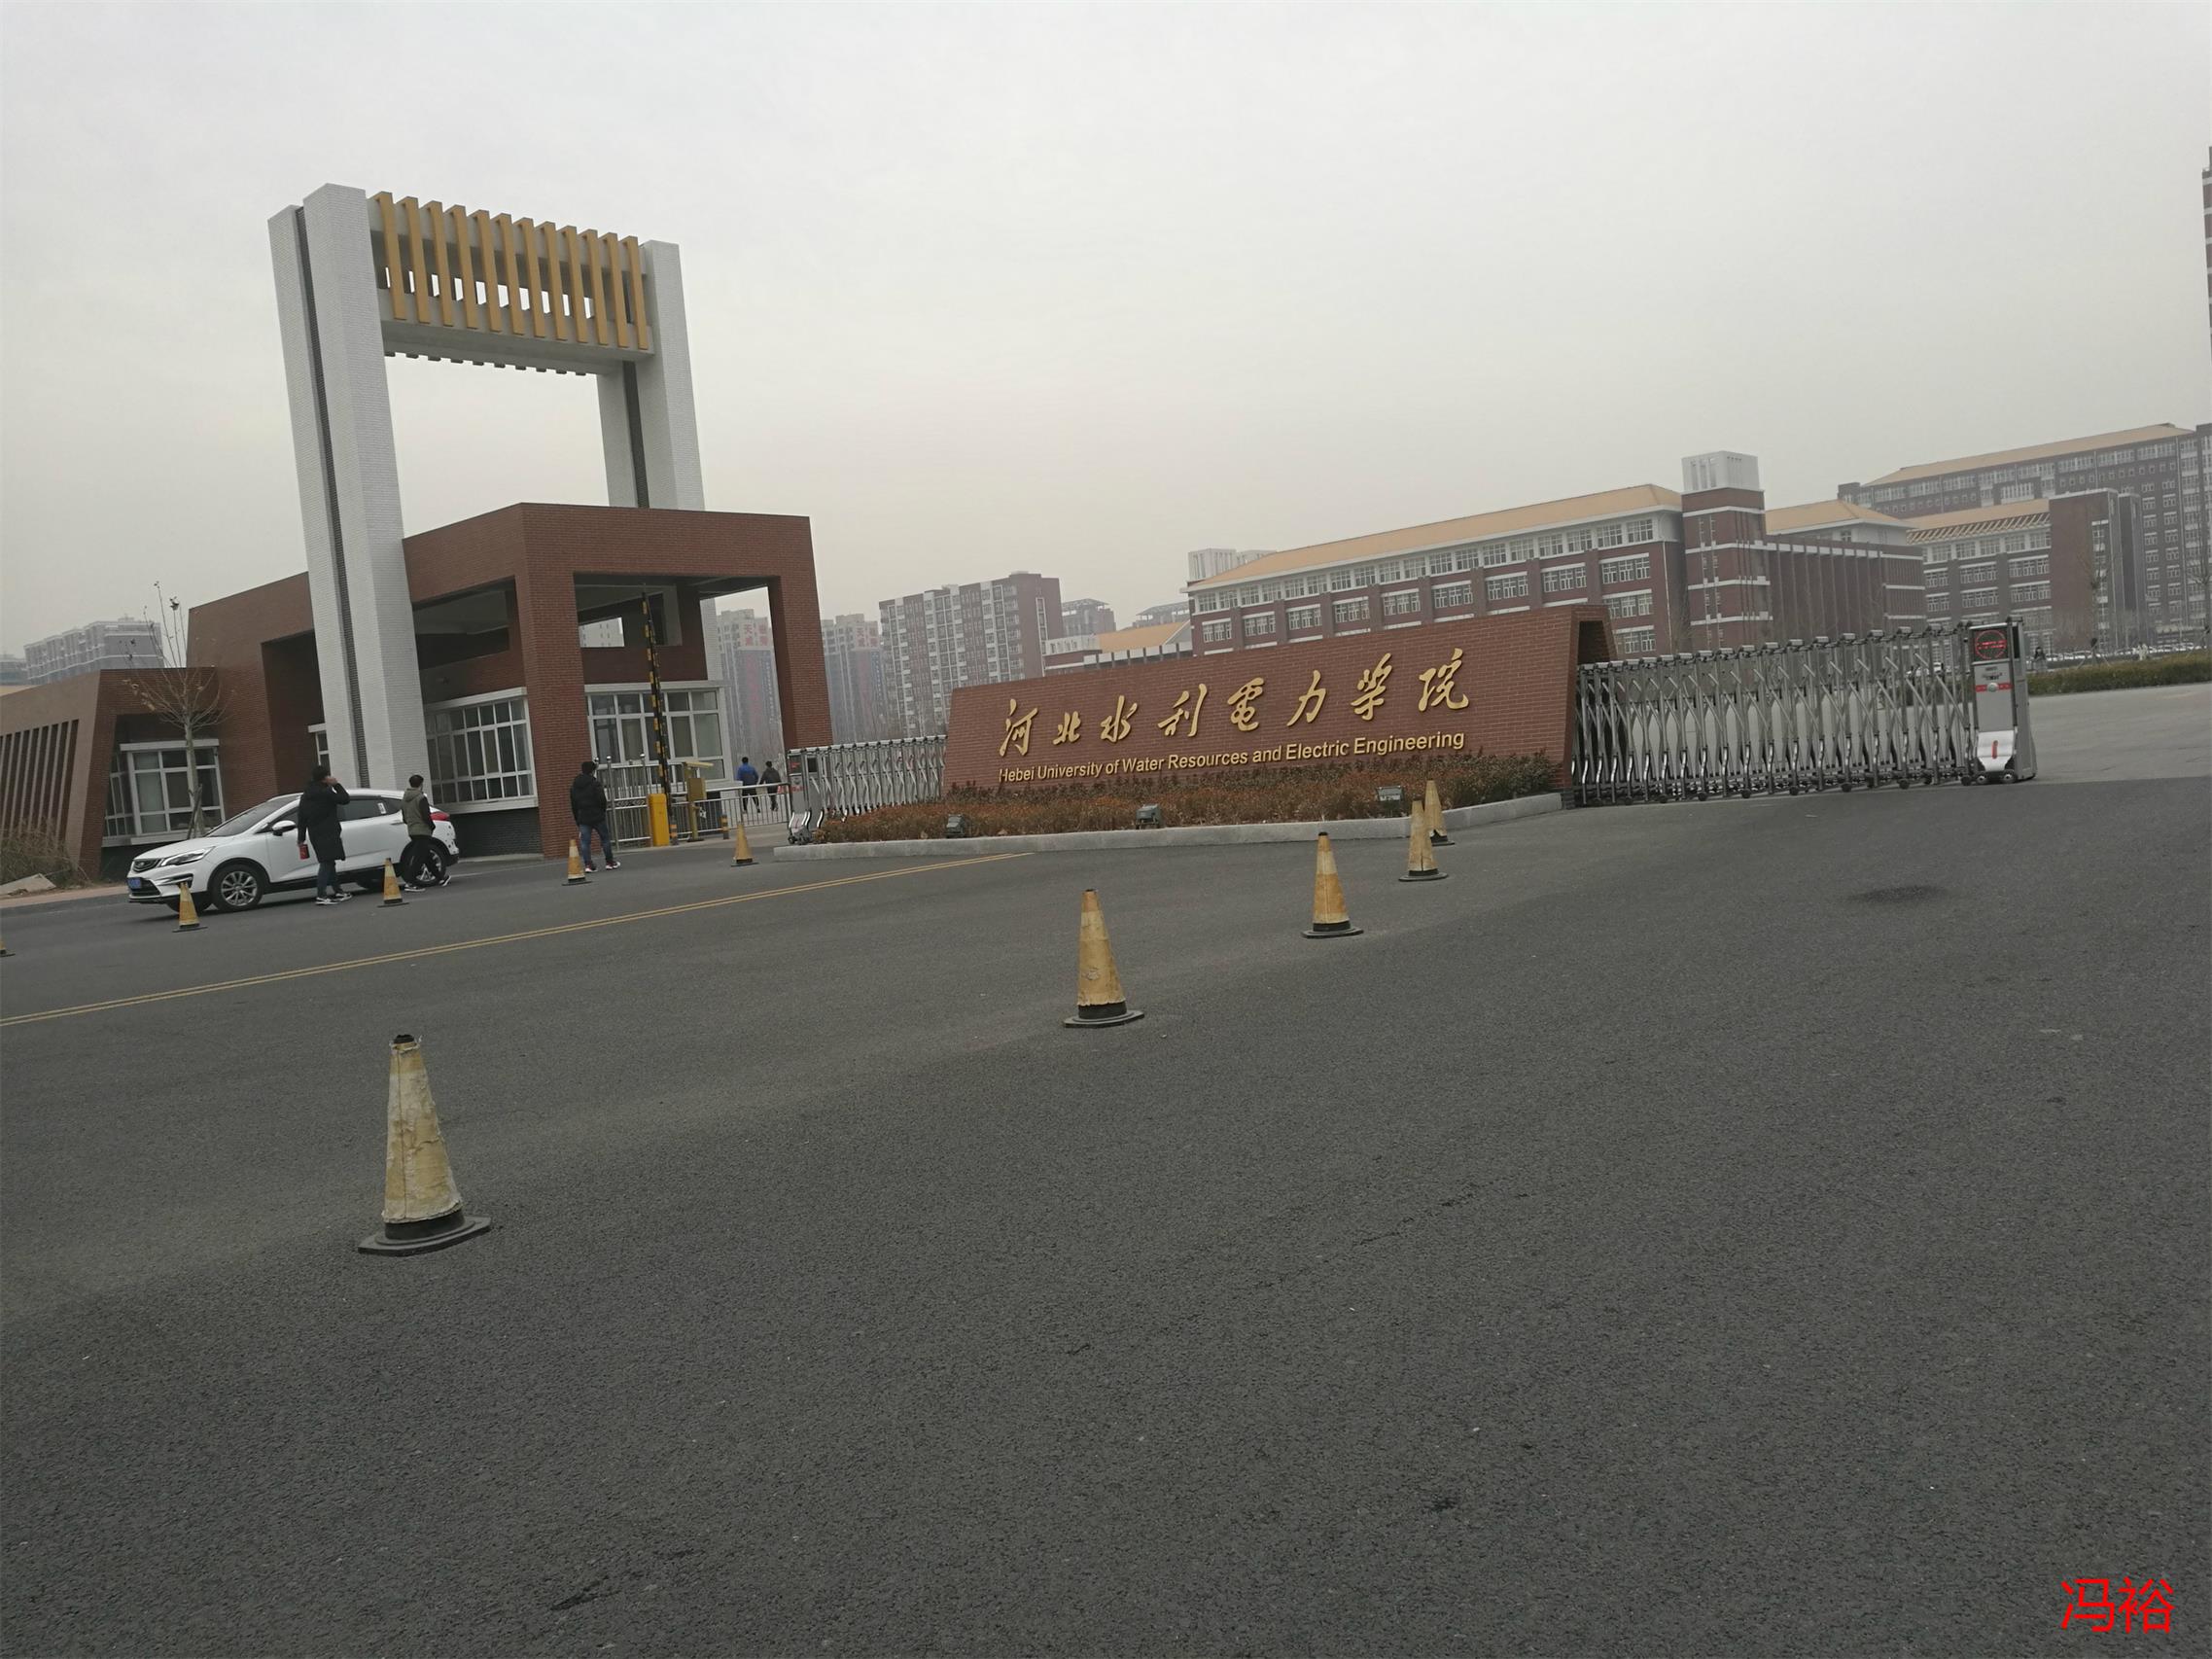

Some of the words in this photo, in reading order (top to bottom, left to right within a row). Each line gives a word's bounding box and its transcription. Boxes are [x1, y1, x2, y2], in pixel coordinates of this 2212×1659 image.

[999, 766, 1035, 783] Hebei
[1036, 761, 1103, 779] University
[1106, 759, 1120, 775] of
[1122, 758, 1164, 773] Water
[1168, 753, 1248, 769] Resources
[1251, 745, 1282, 763] and
[1285, 740, 1350, 759] Electric
[1352, 731, 1464, 755] Engineering
